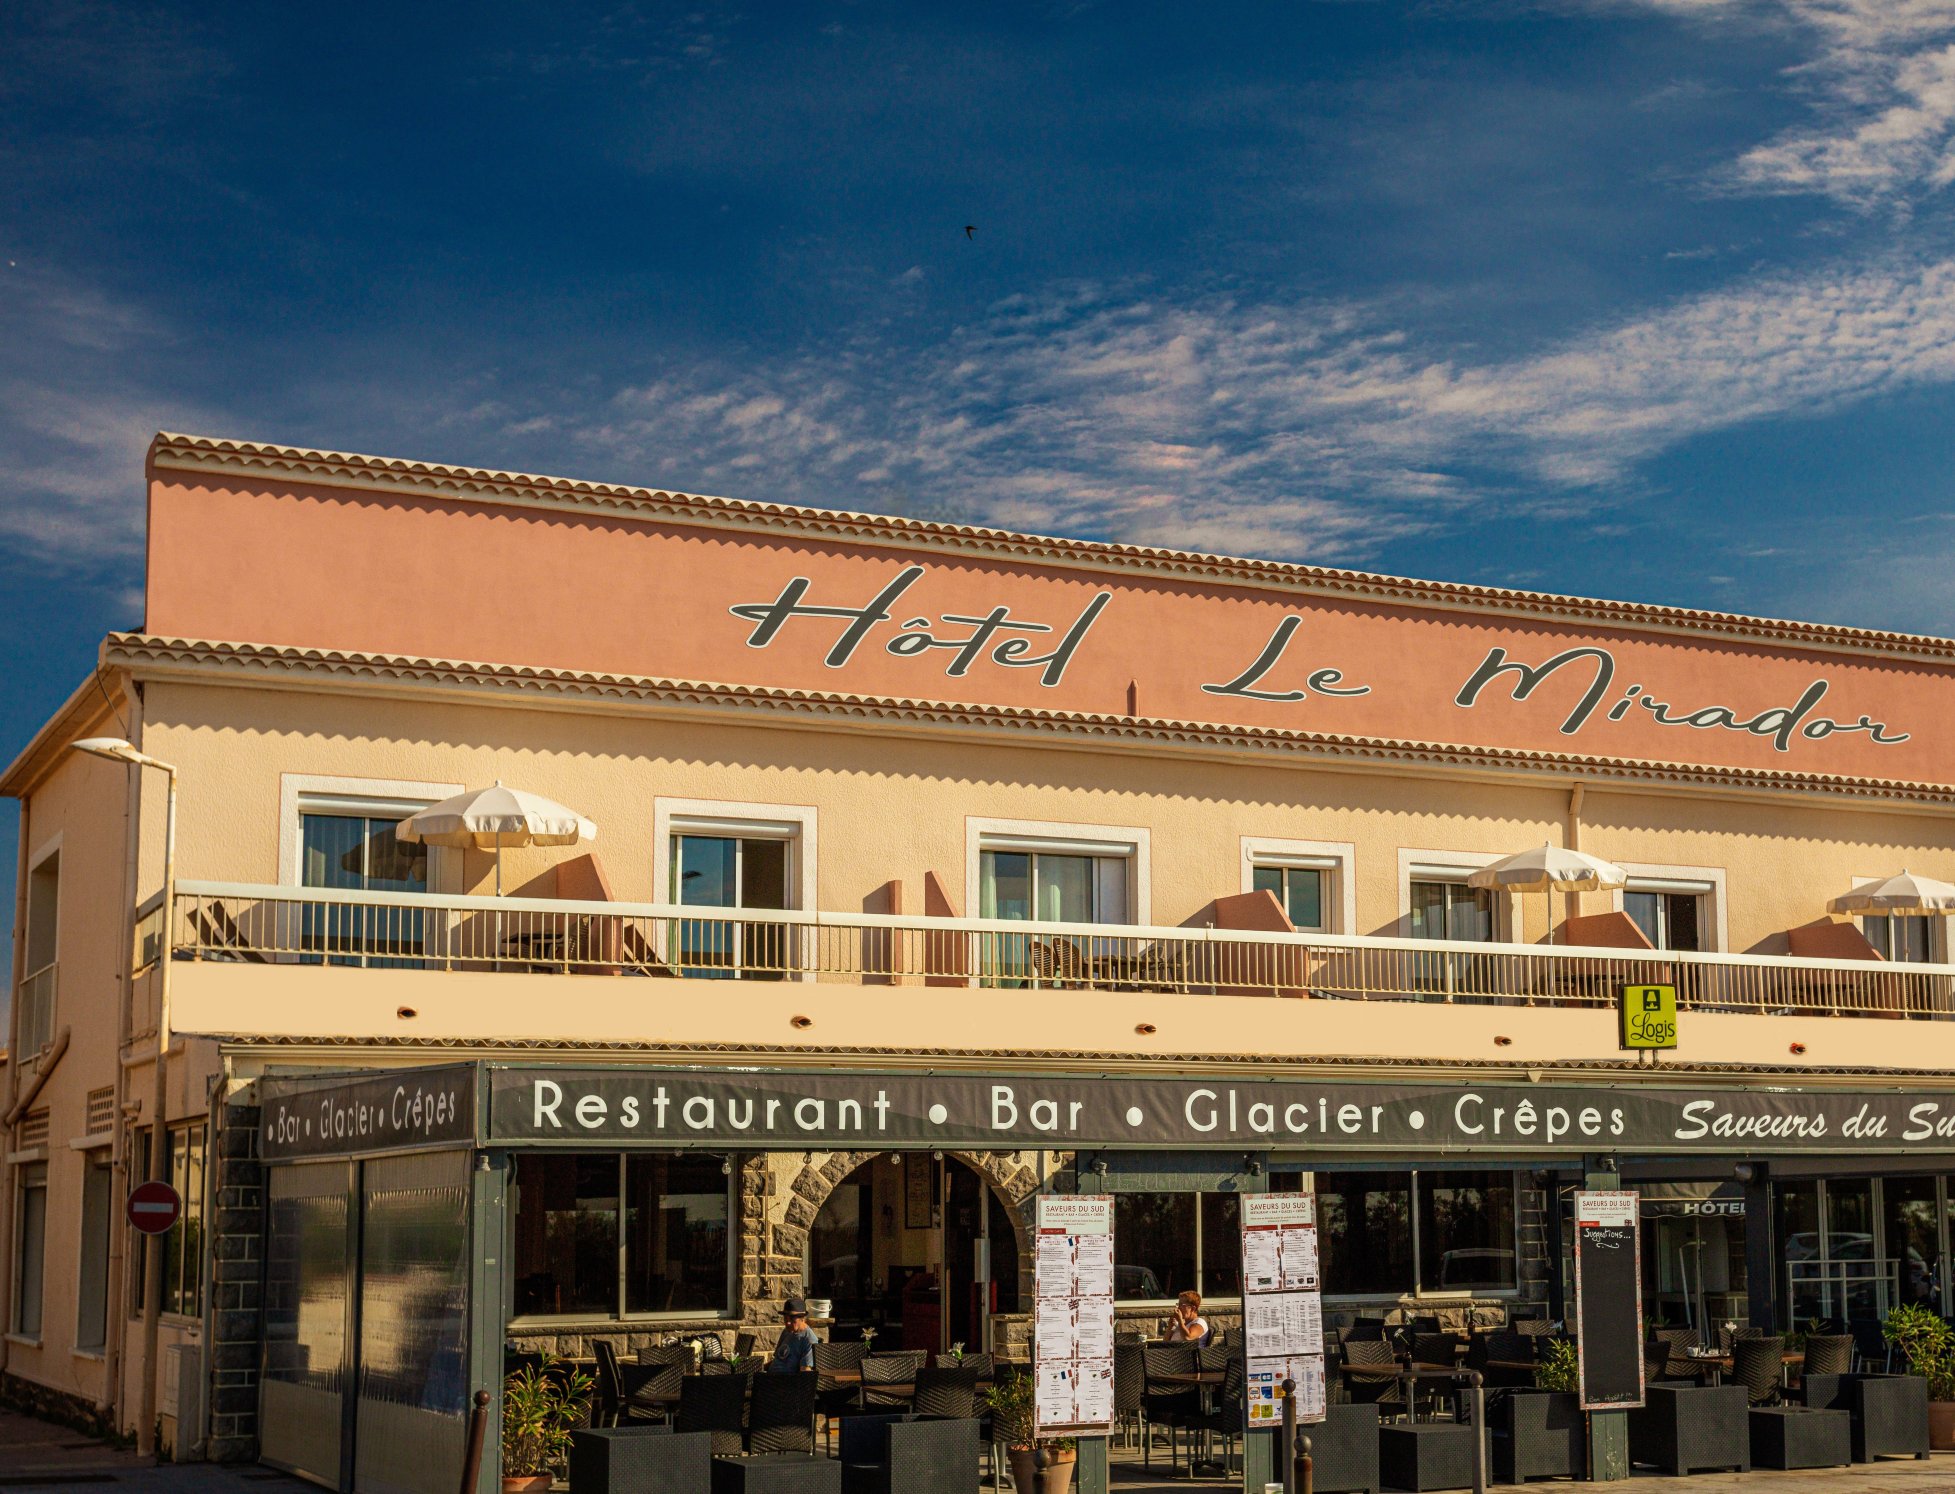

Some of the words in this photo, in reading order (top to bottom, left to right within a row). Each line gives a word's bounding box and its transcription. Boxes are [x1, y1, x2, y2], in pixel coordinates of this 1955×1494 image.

[728, 565, 1113, 688] Hôtel
[1201, 615, 1371, 702] Le
[1454, 647, 1911, 752] Mirador
[1630, 1012, 1675, 1044] Logis
[278, 1106, 300, 1144] Bar
[320, 1098, 374, 1139] Glacier
[392, 1085, 455, 1135] Crêpes
[534, 1080, 890, 1130] Restaurant
[991, 1085, 1083, 1130] Bar
[1185, 1089, 1384, 1133] Glacier
[1454, 1093, 1624, 1143] Crêpes
[1674, 1100, 1828, 1140] Saveurs
[1842, 1103, 1888, 1138] du
